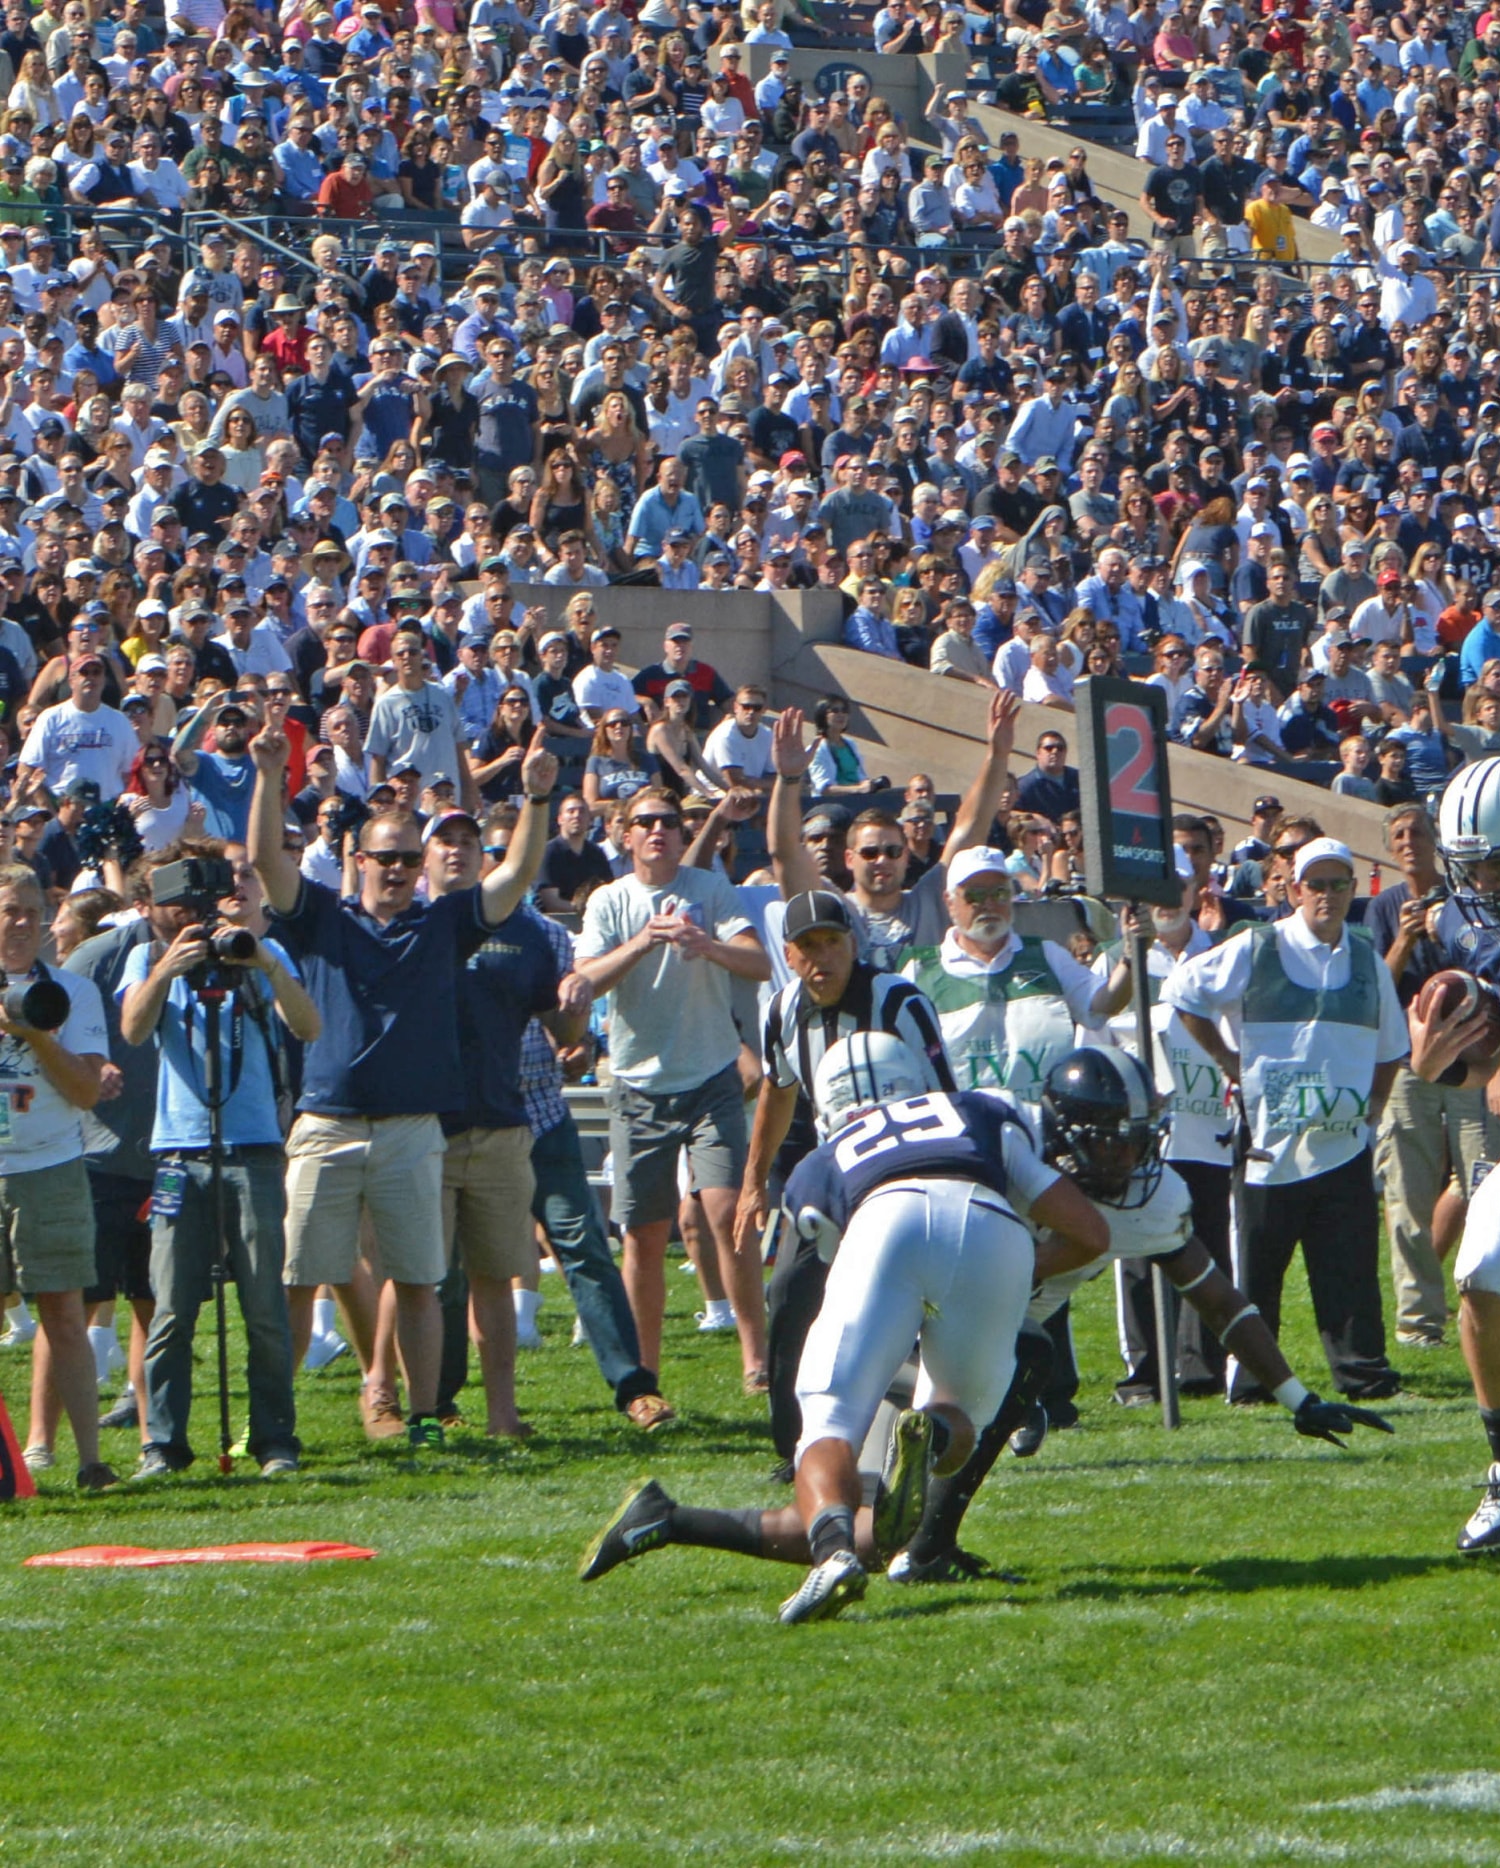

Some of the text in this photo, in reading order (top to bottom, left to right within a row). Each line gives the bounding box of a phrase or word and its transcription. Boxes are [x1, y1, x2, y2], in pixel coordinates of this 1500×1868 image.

[482, 394, 528, 409] YALE
[1271, 619, 1301, 631] YALE
[401, 704, 444, 721] YALE
[1105, 704, 1160, 816] 2
[603, 770, 649, 787] YALE
[966, 1040, 996, 1055] THE
[1171, 1046, 1190, 1063] HE
[967, 1047, 1047, 1090] IVY
[1173, 1062, 1223, 1100] VY
[1296, 1070, 1327, 1086] THE
[1296, 1085, 1369, 1120] IVY
[840, 1090, 963, 1175] 29
